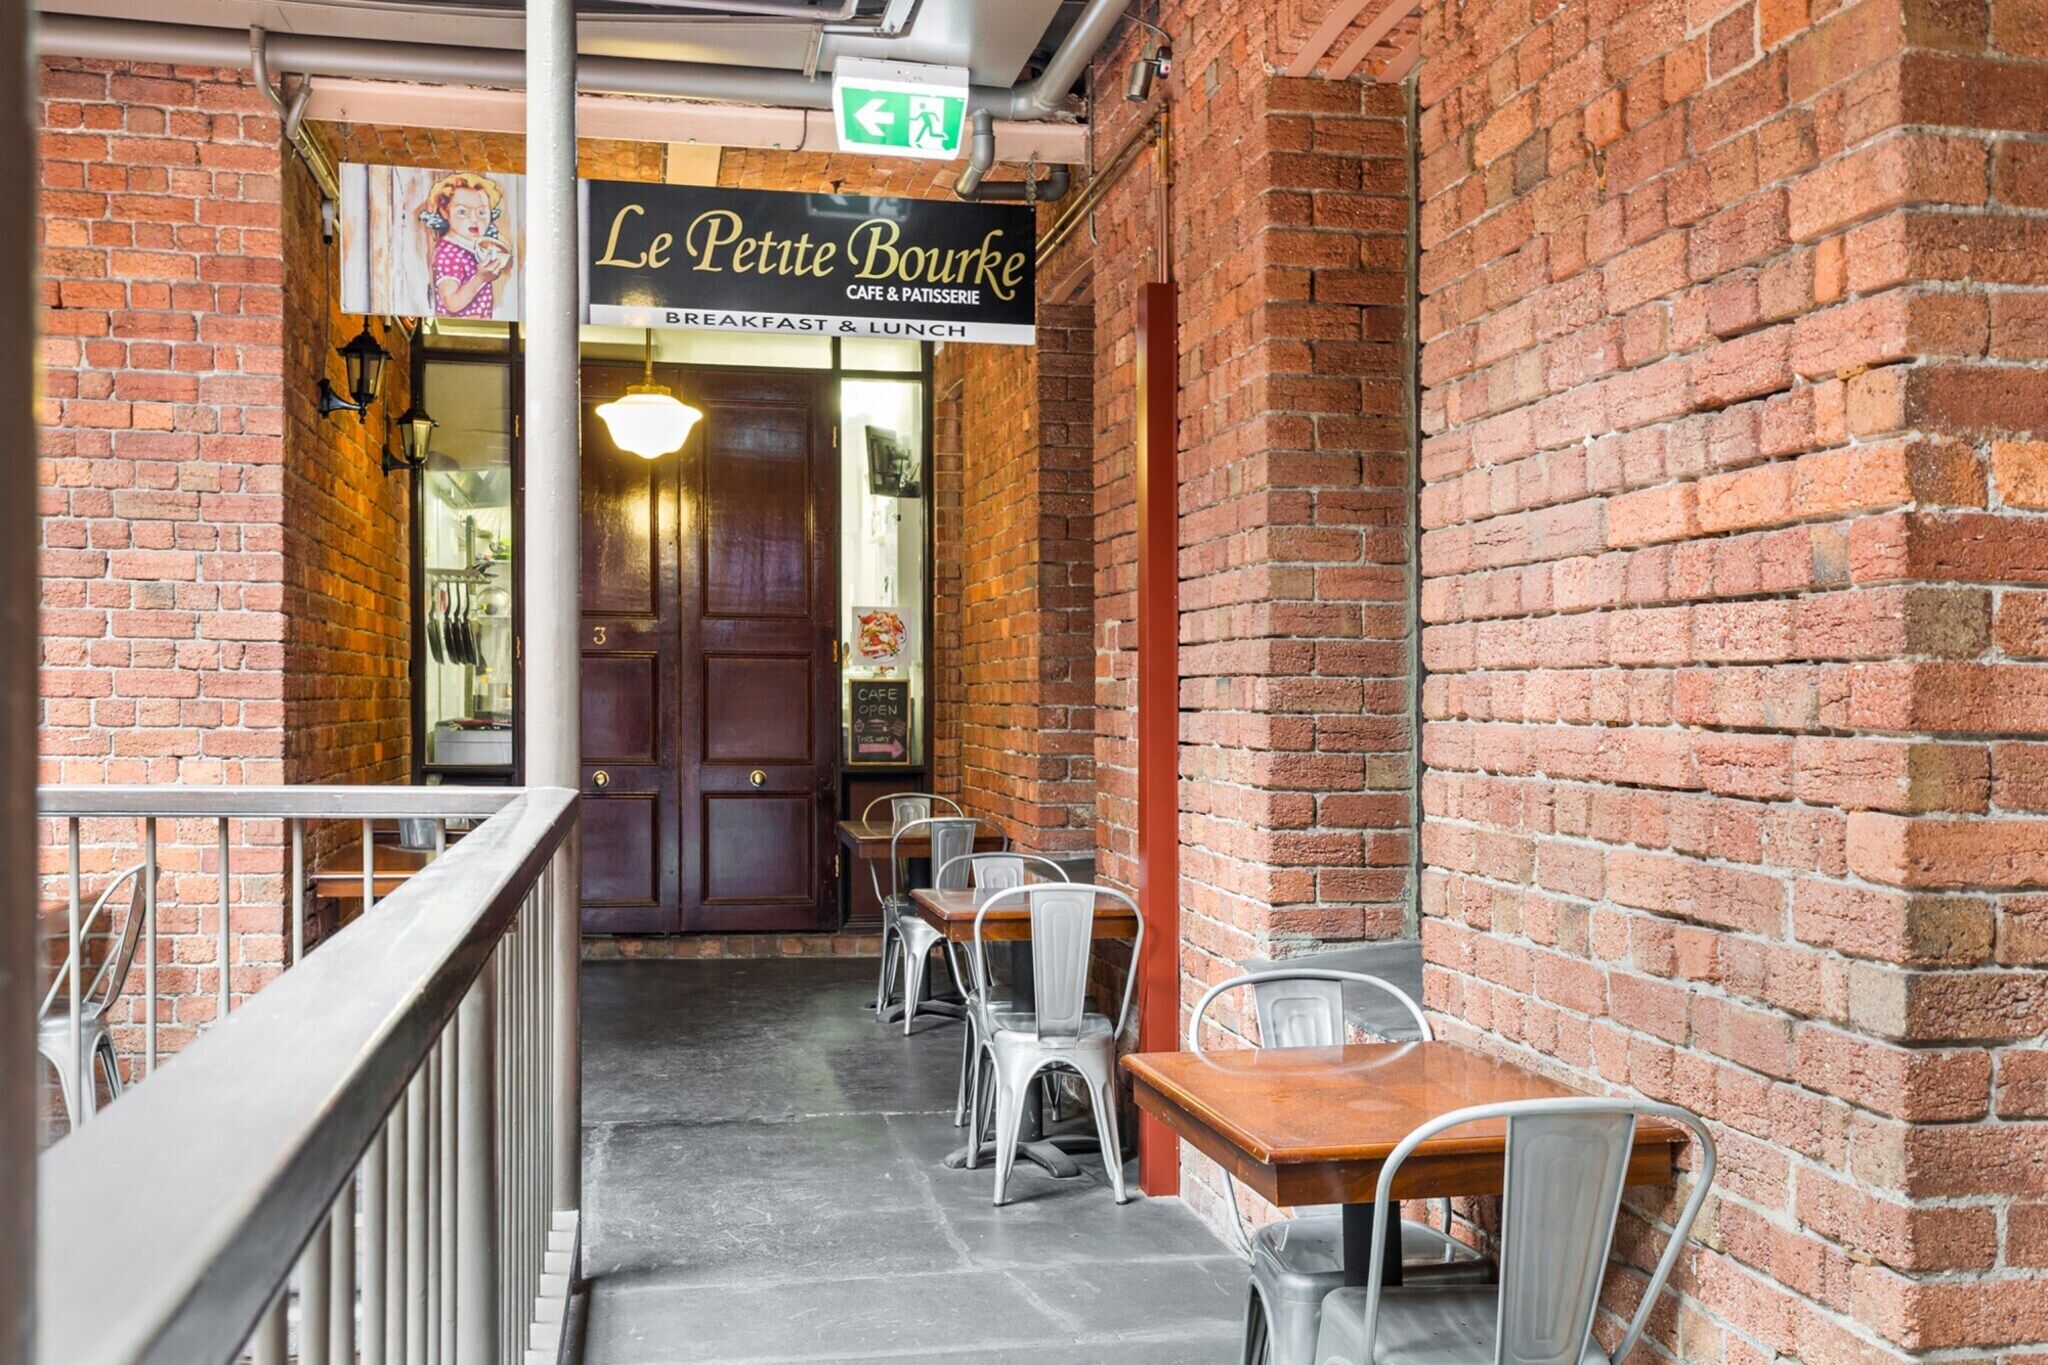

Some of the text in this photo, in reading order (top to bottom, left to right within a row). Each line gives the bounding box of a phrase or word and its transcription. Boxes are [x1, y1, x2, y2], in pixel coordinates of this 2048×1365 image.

[595, 204, 1027, 301] Le Petite Bourke
[846, 285, 980, 305] CAFE & PATISSERIE
[665, 311, 966, 337] BREAKFAST & LUNCH
[593, 626, 606, 645] 3
[858, 688, 898, 701] CAFE
[859, 704, 898, 716] OPEN
